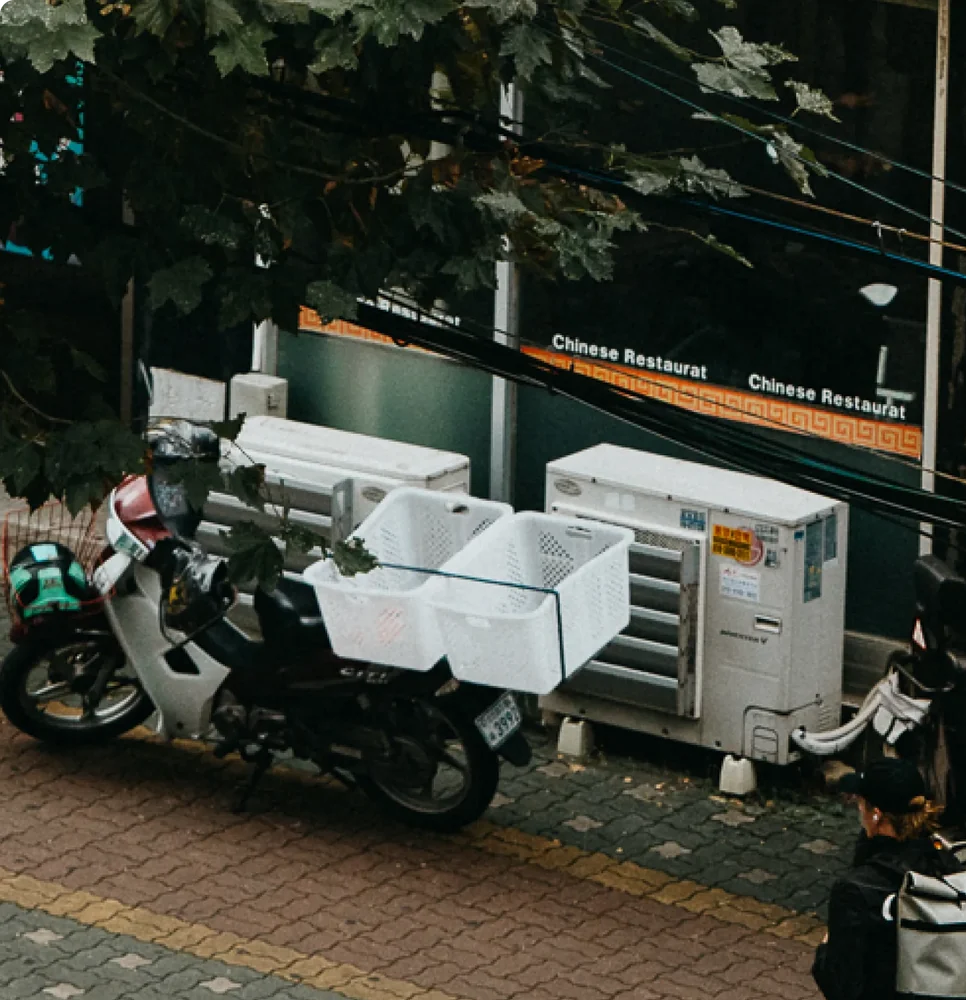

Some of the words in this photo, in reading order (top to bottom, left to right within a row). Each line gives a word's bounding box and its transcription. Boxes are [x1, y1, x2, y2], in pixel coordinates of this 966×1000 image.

[552, 334, 620, 361] Chinese
[624, 347, 708, 381] Restaurat
[748, 373, 817, 402] Chinese
[821, 387, 907, 420] Restaurat
